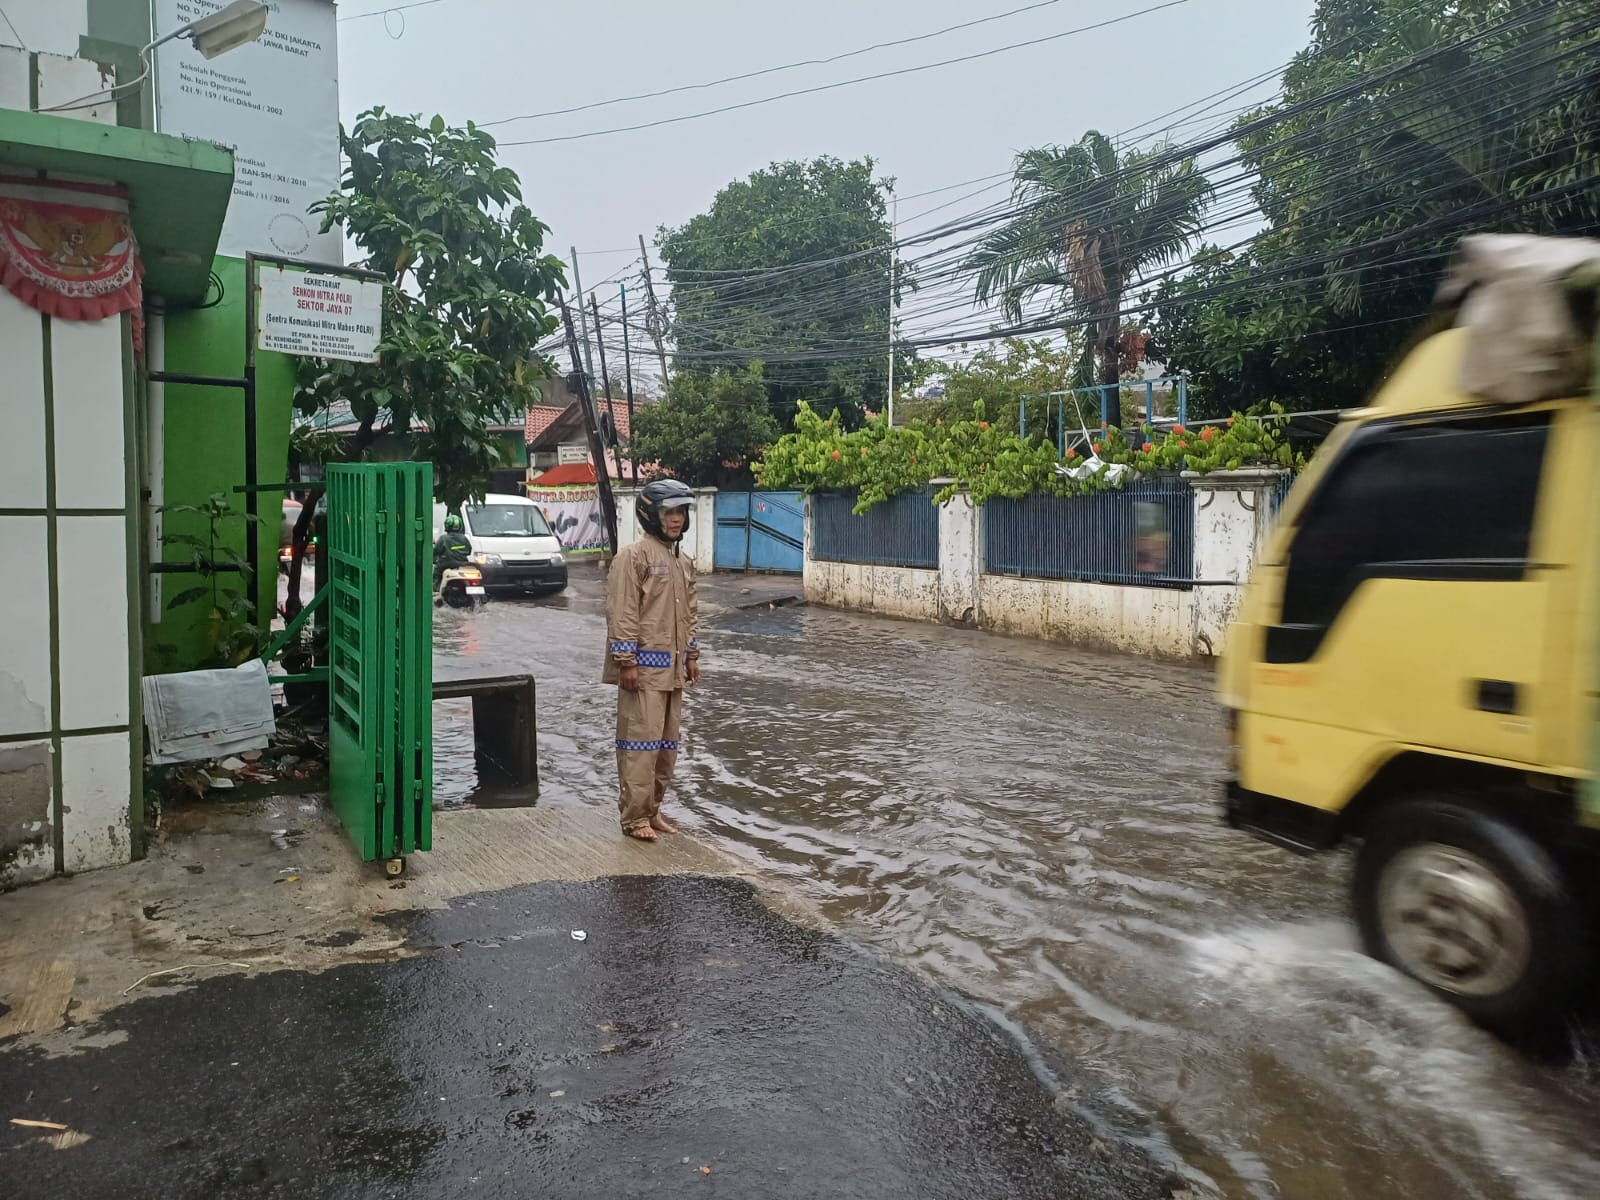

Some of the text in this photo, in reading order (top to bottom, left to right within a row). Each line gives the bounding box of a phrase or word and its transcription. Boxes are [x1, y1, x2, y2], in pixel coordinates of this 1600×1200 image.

[263, 39, 283, 50] JAWA
[285, 45, 309, 57] BARAT
[290, 35, 321, 50] JAKARTA
[179, 61, 208, 75] Sekolah
[210, 81, 252, 97] Operasional
[303, 277, 341, 290] SEKRETARIAT
[316, 290, 335, 301] MITRA
[335, 292, 353, 304] POLRI
[297, 299, 324, 312] SEKTOR
[326, 303, 342, 314] JAYA
[288, 316, 321, 329] Komunikasi
[321, 320, 336, 330] Mitra
[337, 321, 355, 332] Mabes
